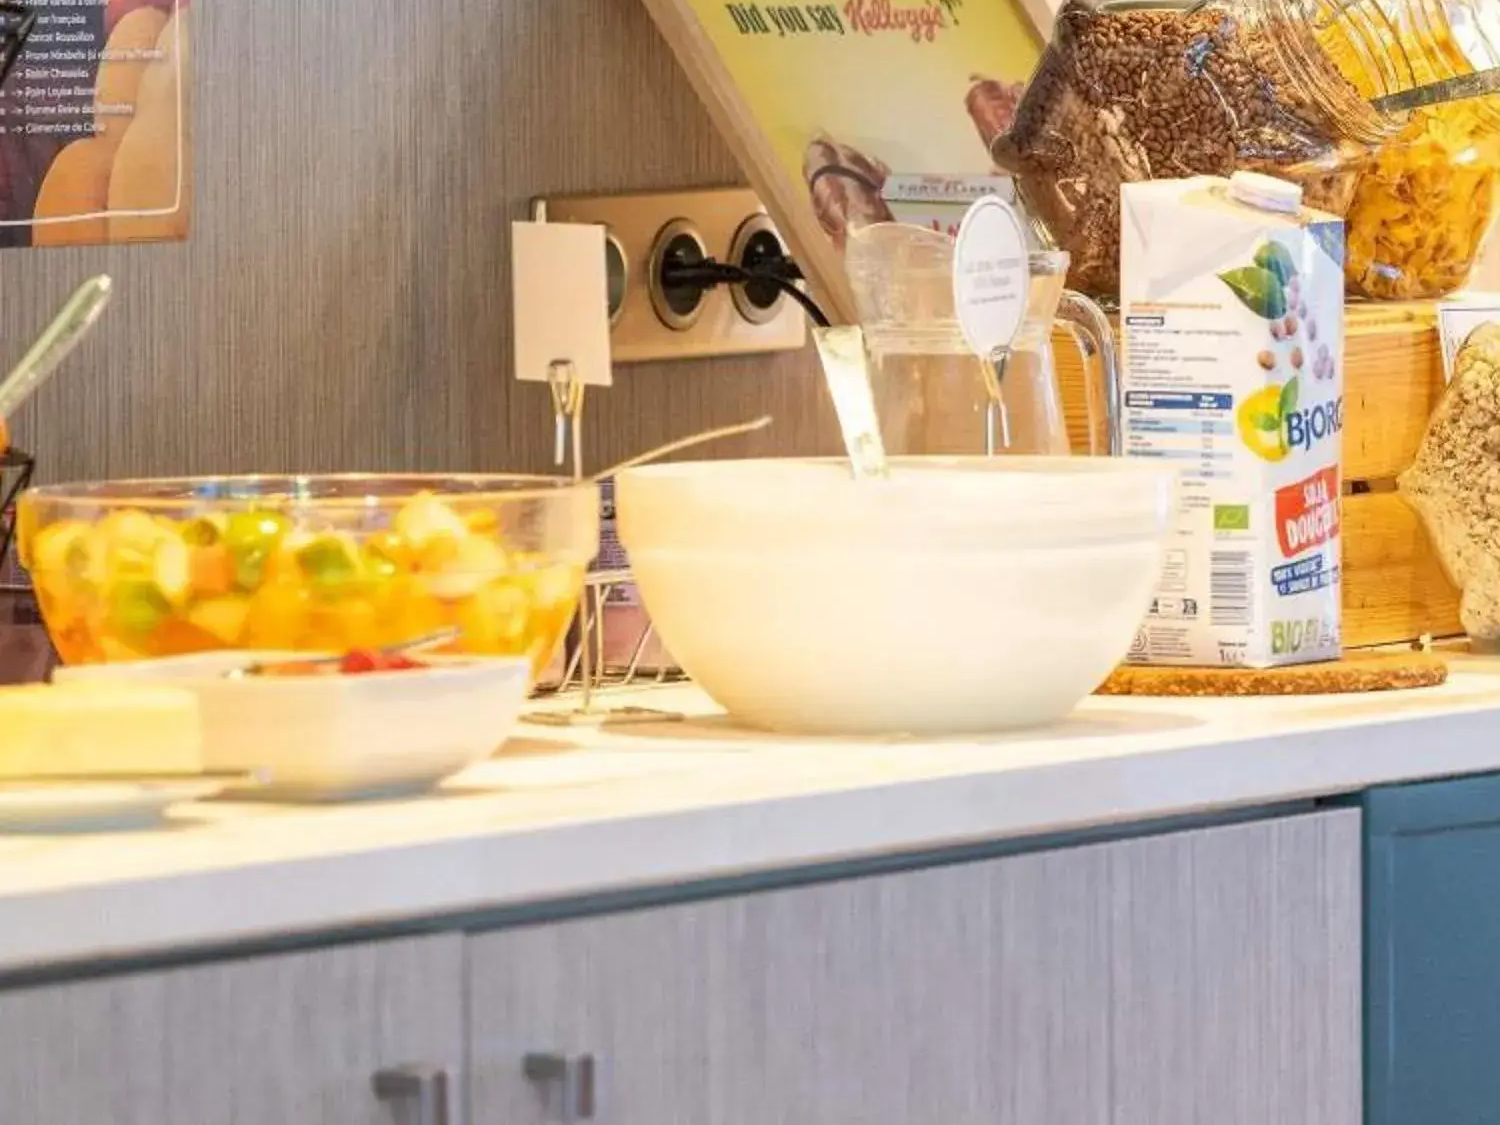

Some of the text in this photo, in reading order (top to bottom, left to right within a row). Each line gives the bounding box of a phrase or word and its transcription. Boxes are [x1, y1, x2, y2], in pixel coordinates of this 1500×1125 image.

[725, 2, 770, 35] Did
[766, 4, 811, 38] you
[807, 3, 845, 36] say
